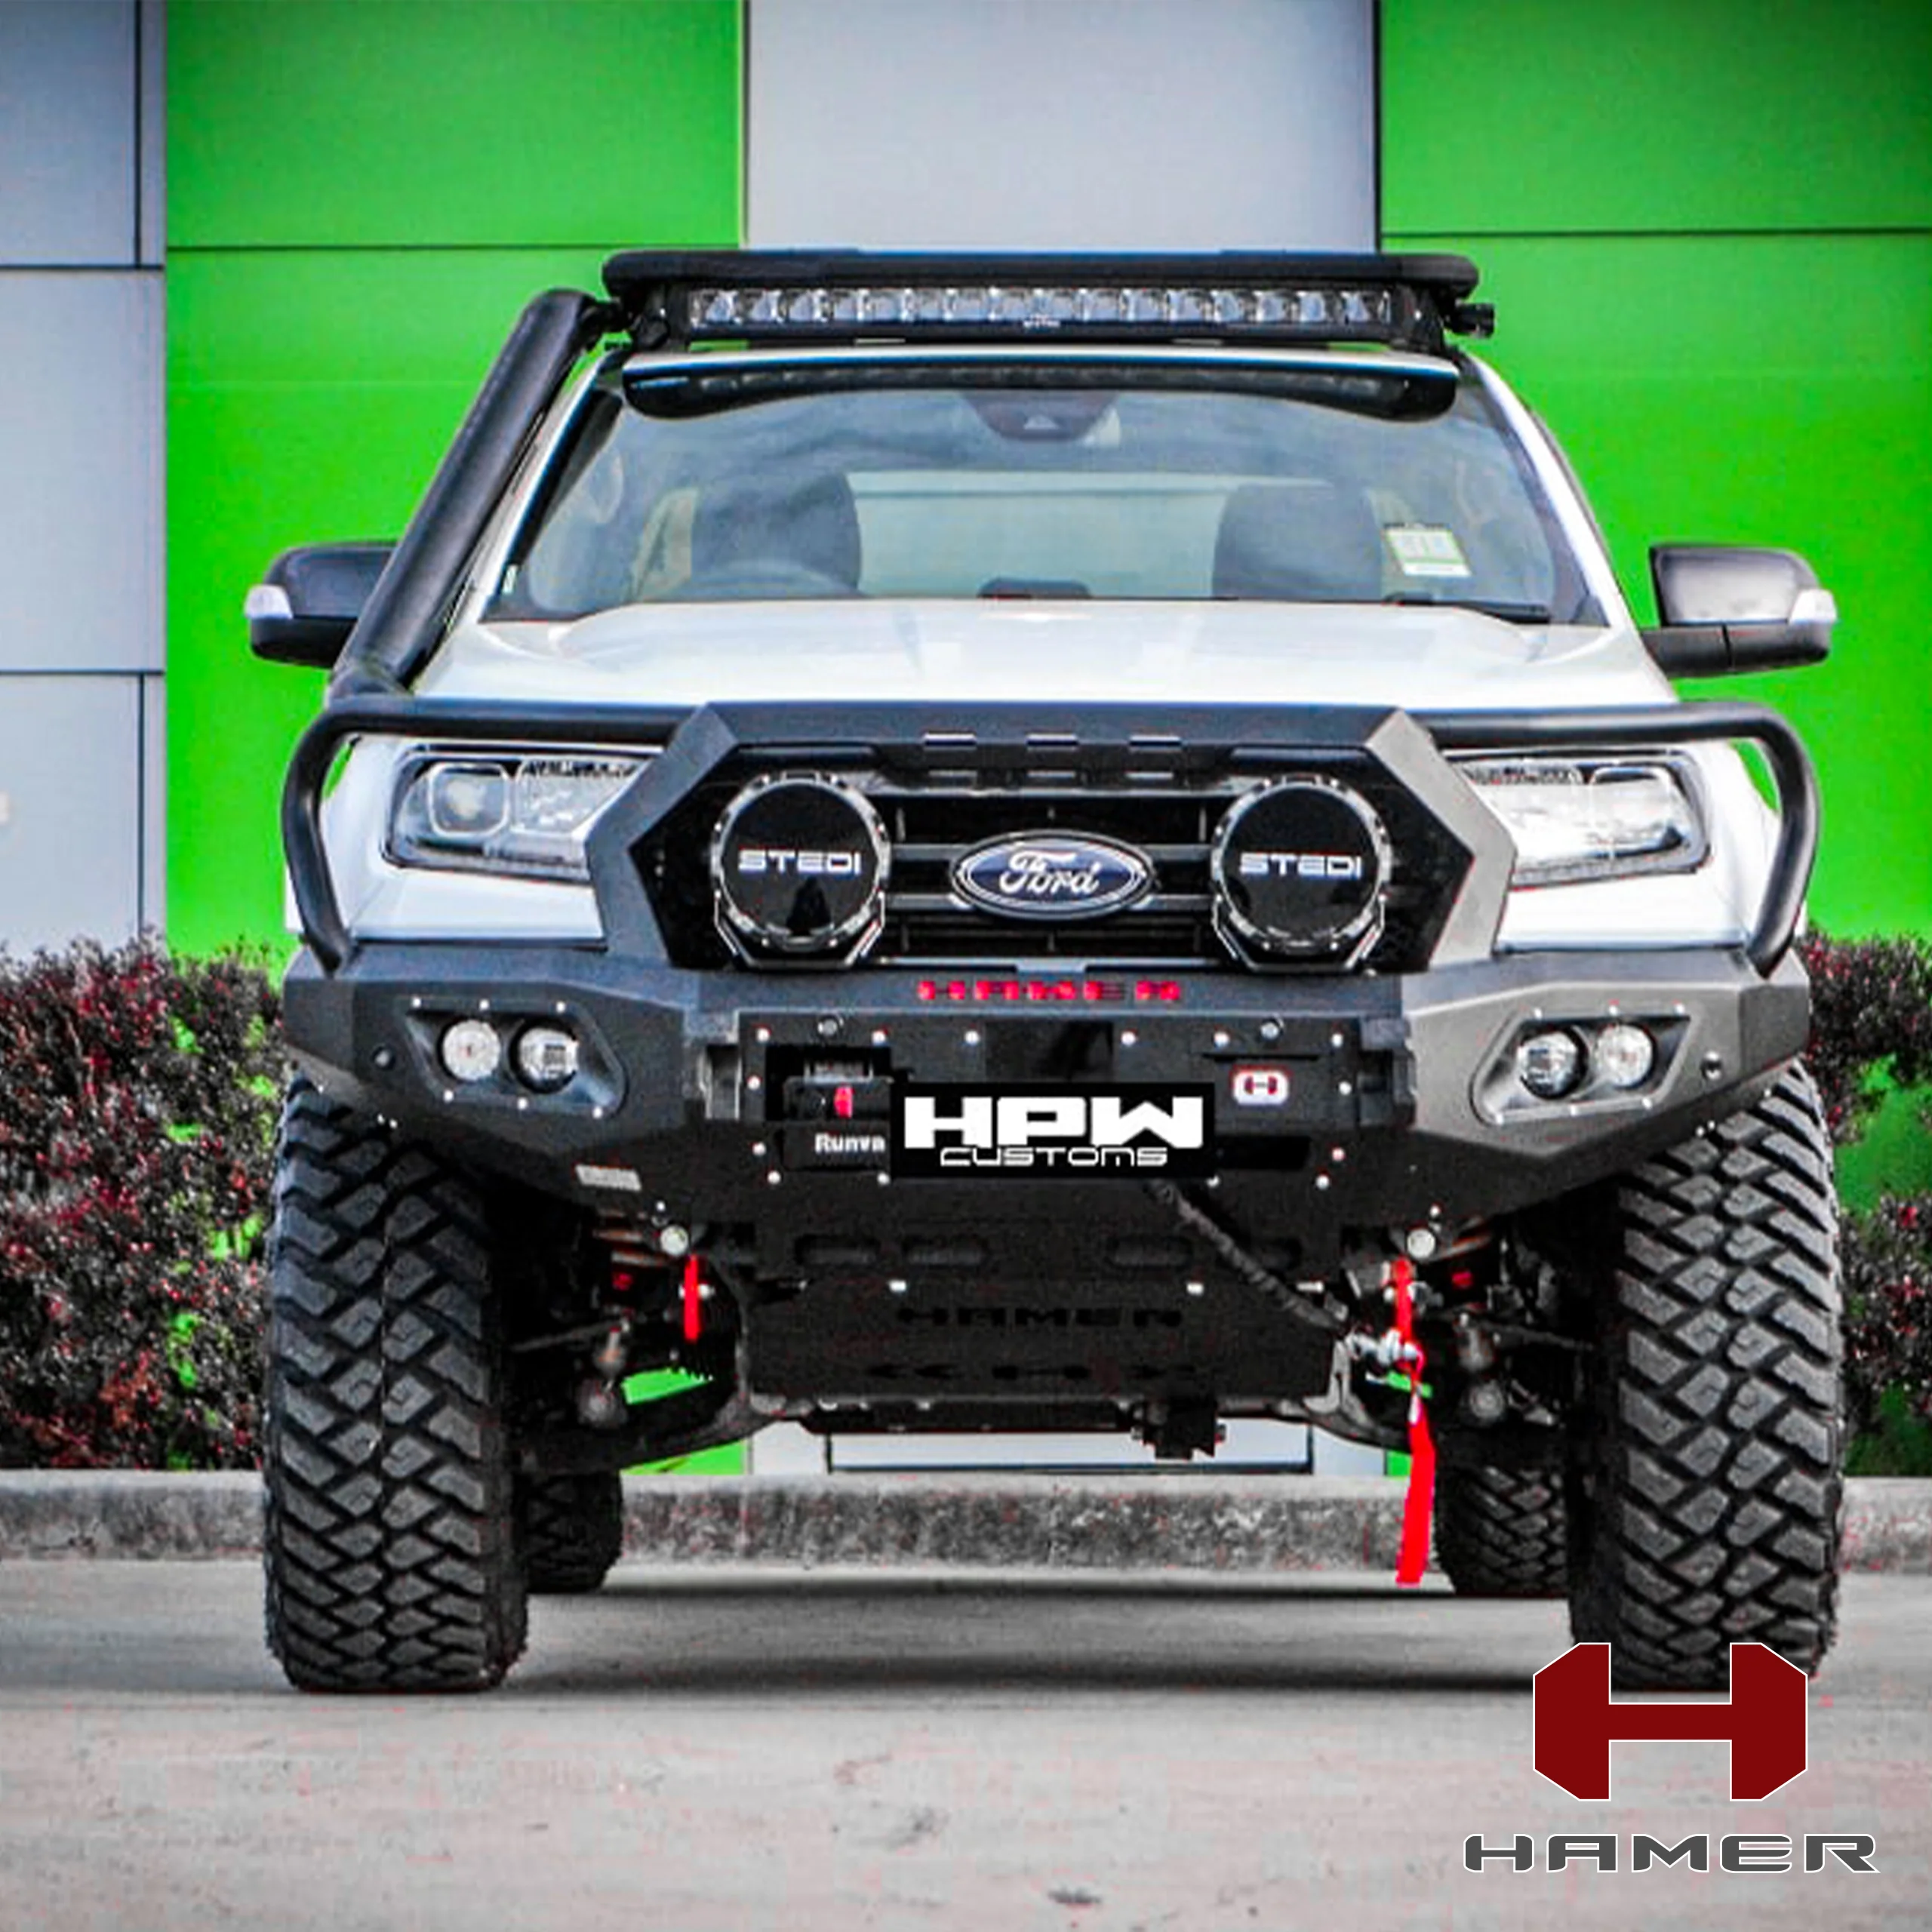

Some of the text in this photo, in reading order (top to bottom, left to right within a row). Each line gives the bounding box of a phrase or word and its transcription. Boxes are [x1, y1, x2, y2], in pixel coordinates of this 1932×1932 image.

[738, 849, 861, 876] STEDI
[999, 851, 1103, 894] Ford
[1239, 852, 1361, 879] STEDI
[904, 1097, 1204, 1149] HPW
[940, 1147, 1168, 1167] CUSTOMS
